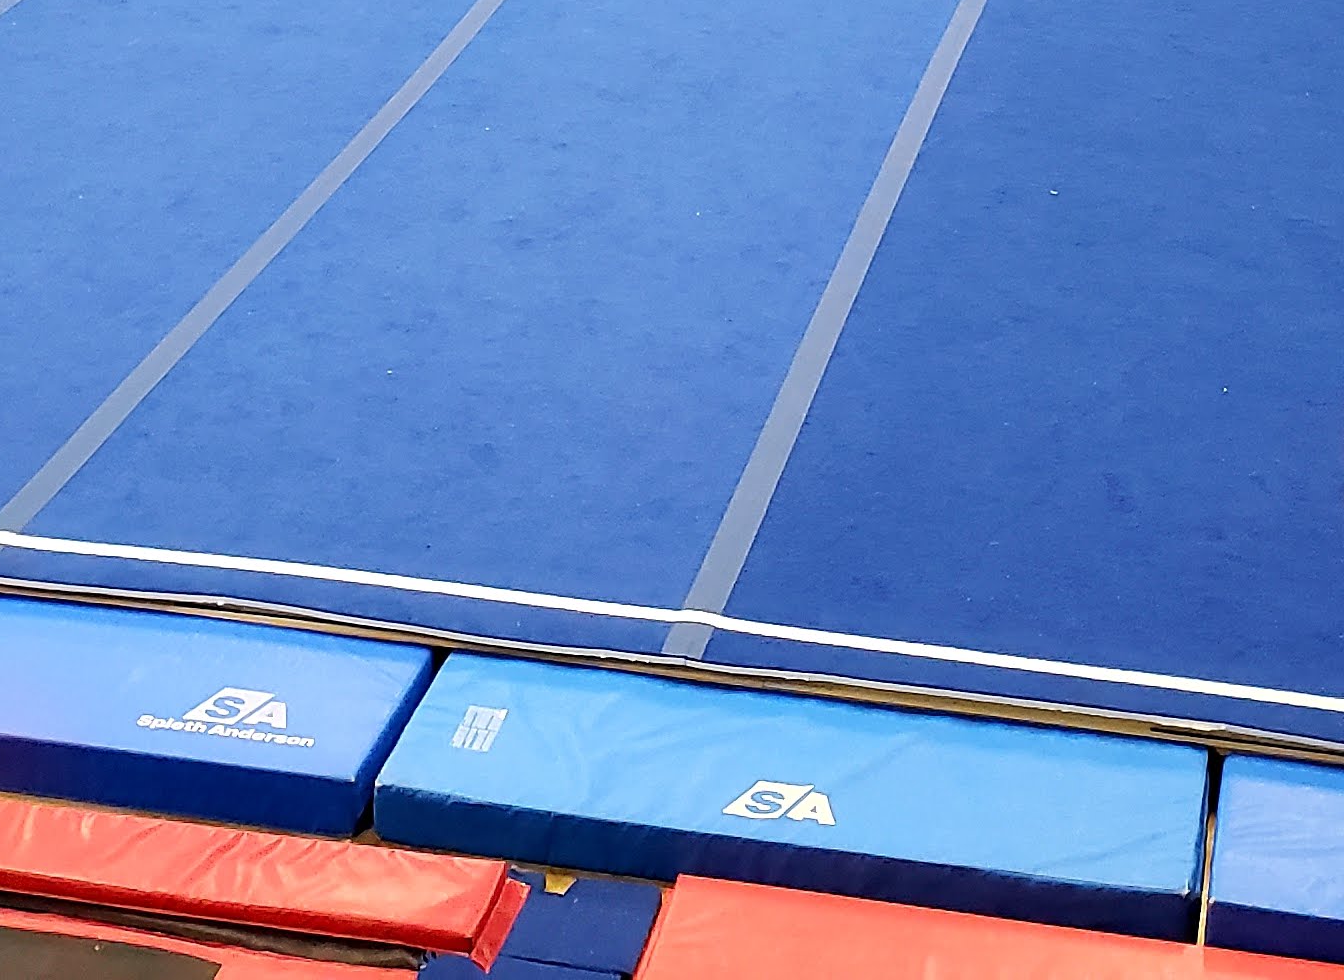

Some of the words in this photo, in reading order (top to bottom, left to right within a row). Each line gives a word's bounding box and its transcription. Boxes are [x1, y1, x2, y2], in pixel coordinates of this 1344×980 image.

[182, 687, 287, 729] SA
[208, 724, 316, 748] Anderson
[721, 780, 836, 826] SA
